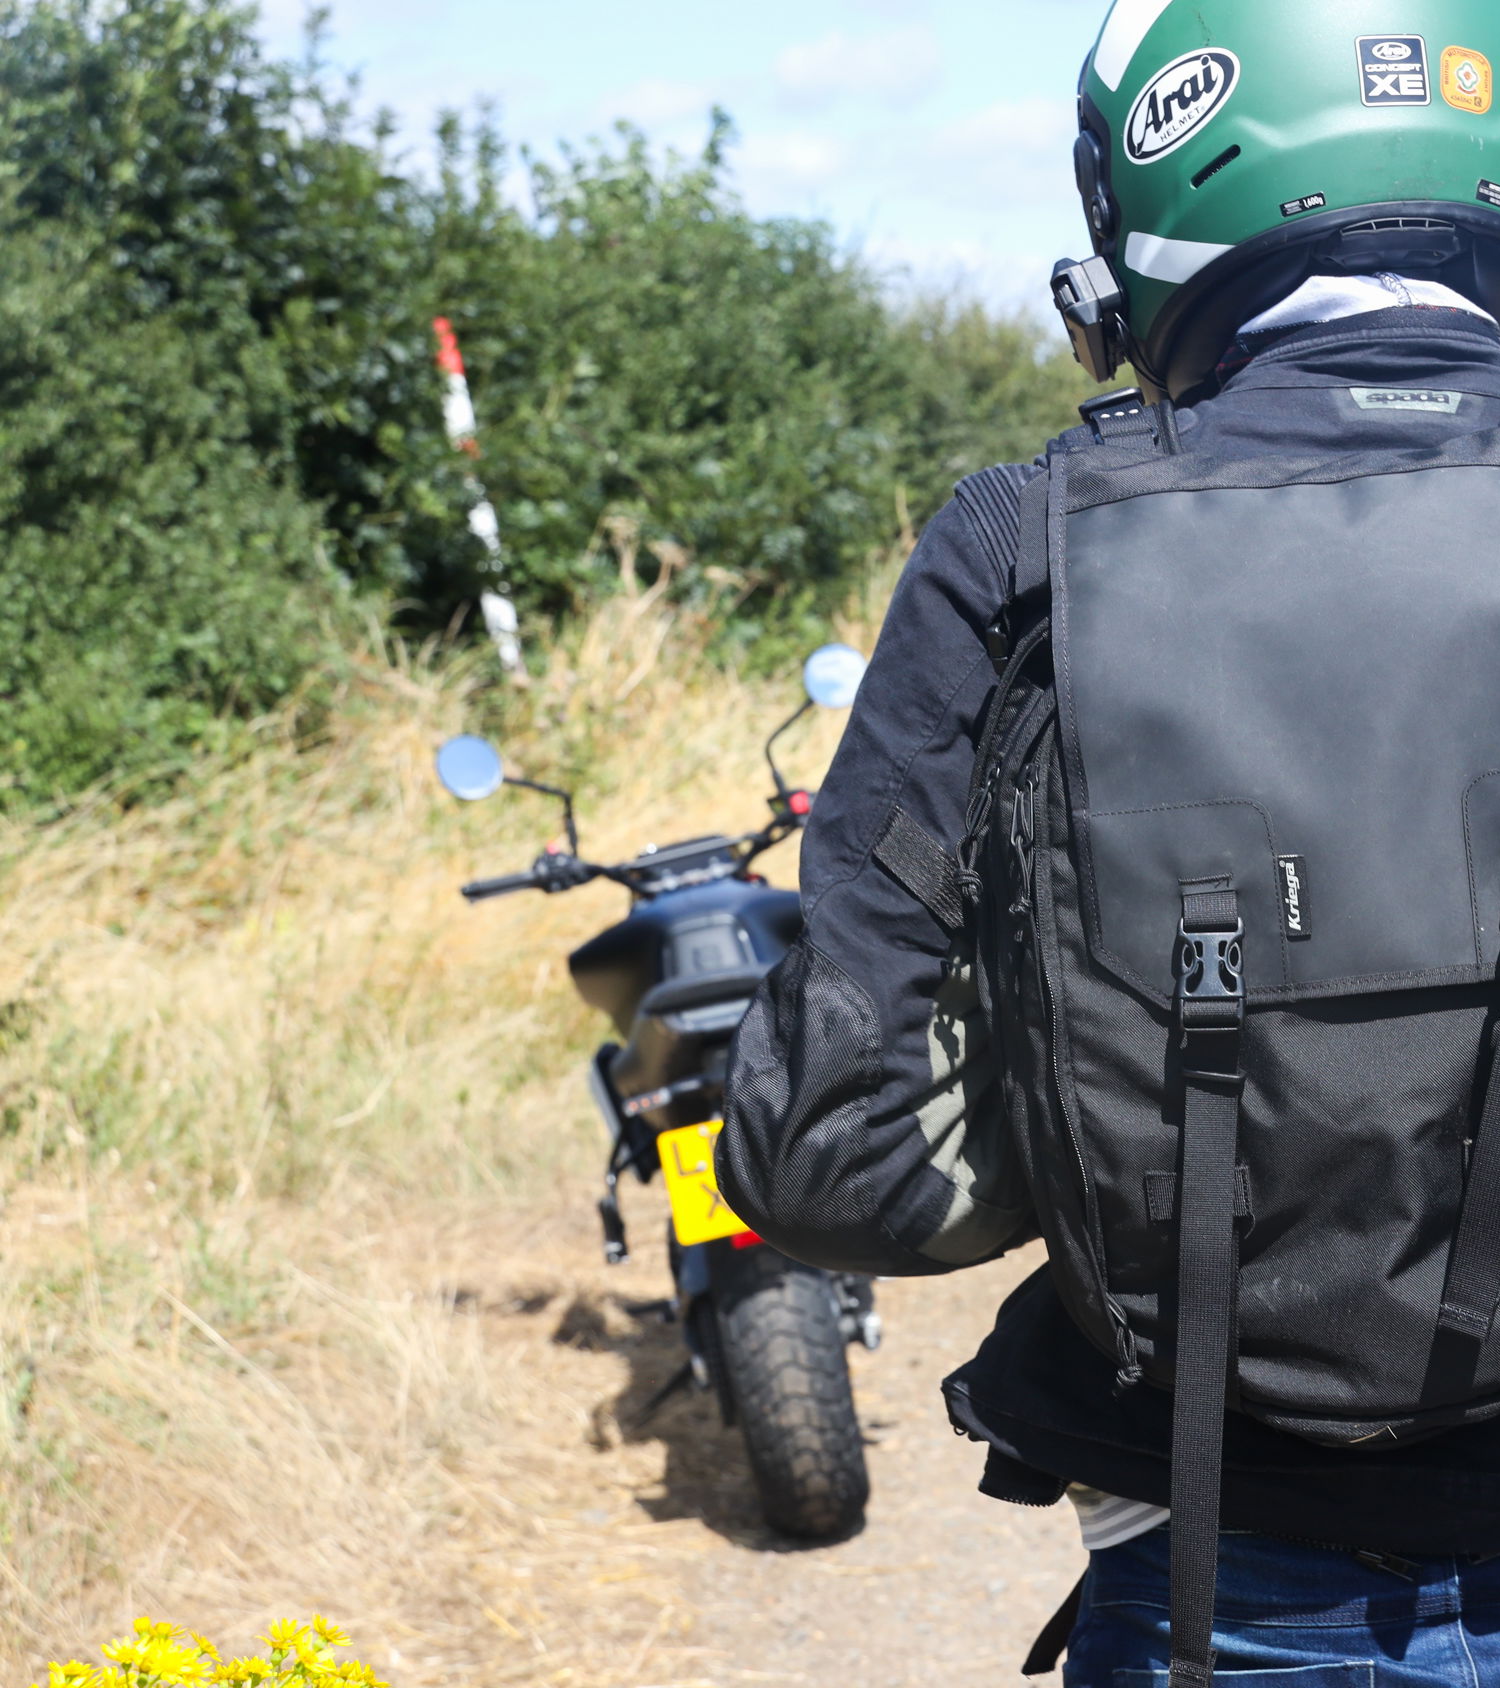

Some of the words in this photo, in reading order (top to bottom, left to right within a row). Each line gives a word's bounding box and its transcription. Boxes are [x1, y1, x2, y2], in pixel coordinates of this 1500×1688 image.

[1364, 63, 1422, 73] CONCEPT
[1366, 74, 1425, 97] XE
[1134, 54, 1219, 156] Arai
[1159, 106, 1201, 142] HELMET
[1284, 862, 1302, 931] Kriega
